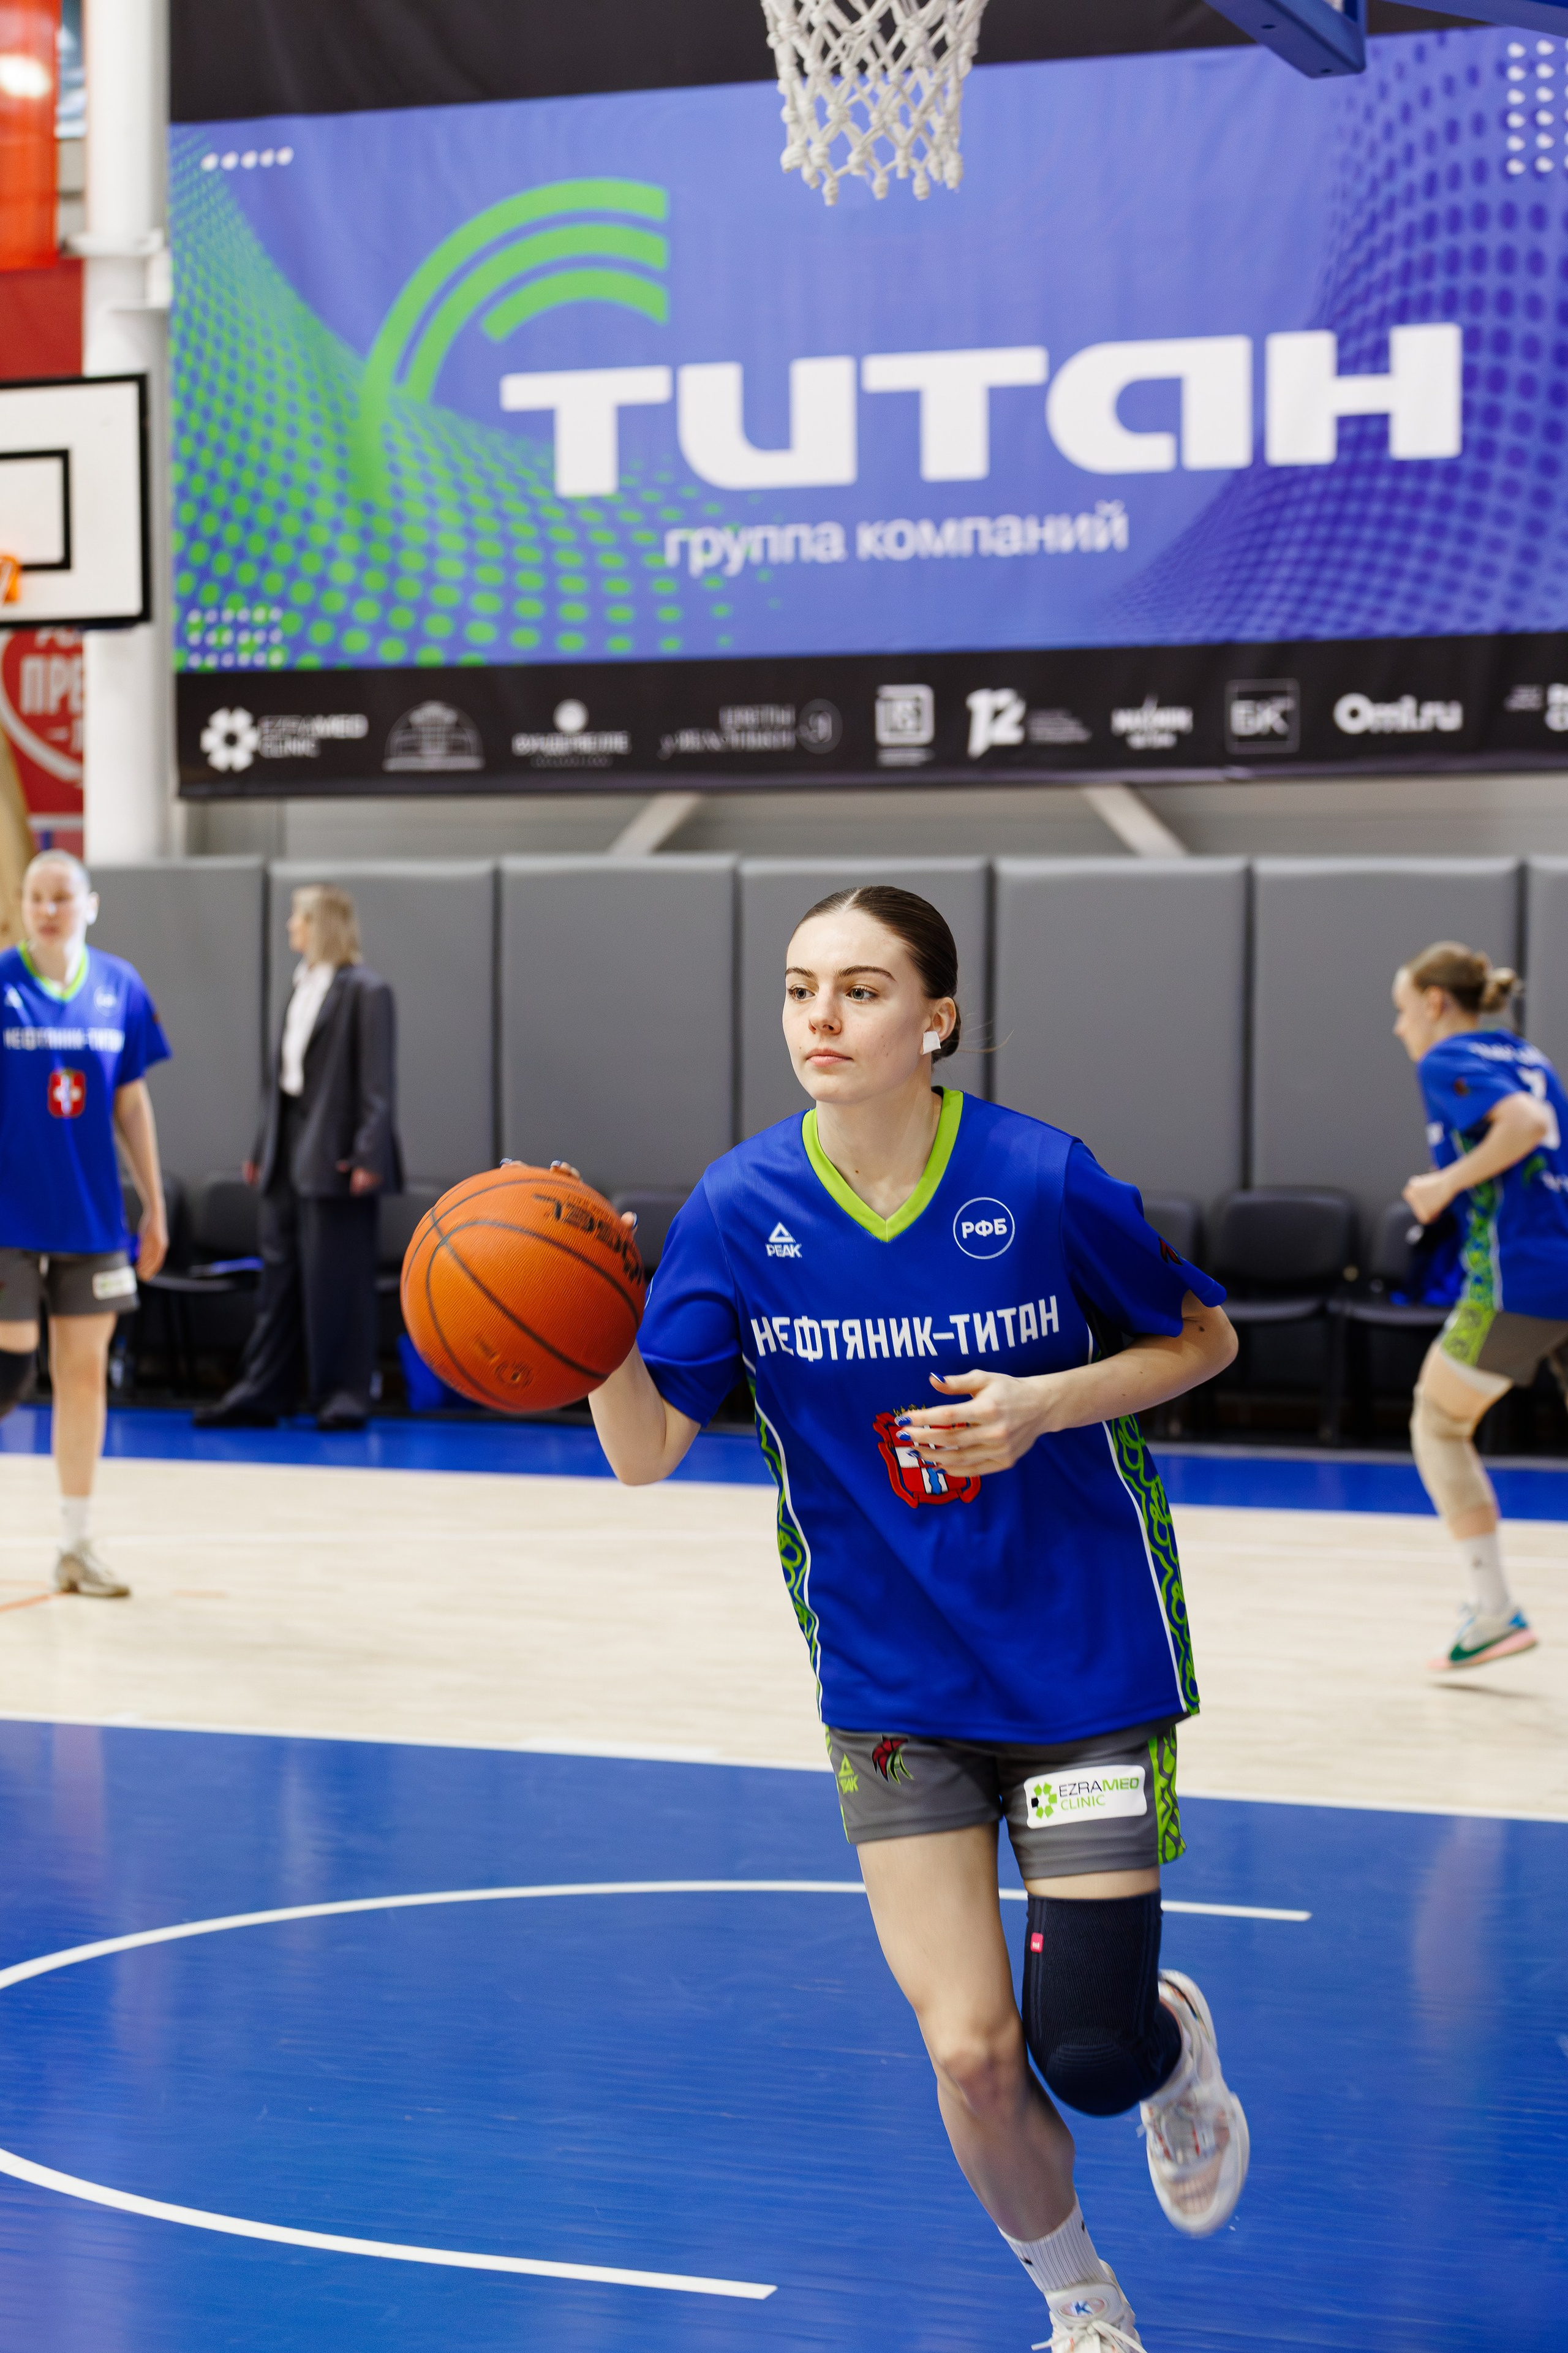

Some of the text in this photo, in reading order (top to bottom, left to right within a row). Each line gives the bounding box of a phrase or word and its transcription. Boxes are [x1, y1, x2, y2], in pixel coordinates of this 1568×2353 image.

[665, 499, 1129, 578] группа компаний
[962, 1218, 1007, 1239] РФБ
[765, 1244, 802, 1258] PEAK
[751, 1295, 1059, 1362] НЕФТЯНИК-ТИТАН
[1059, 1777, 1139, 1797] EZRAMED
[1061, 1794, 1106, 1811] CLINIC
